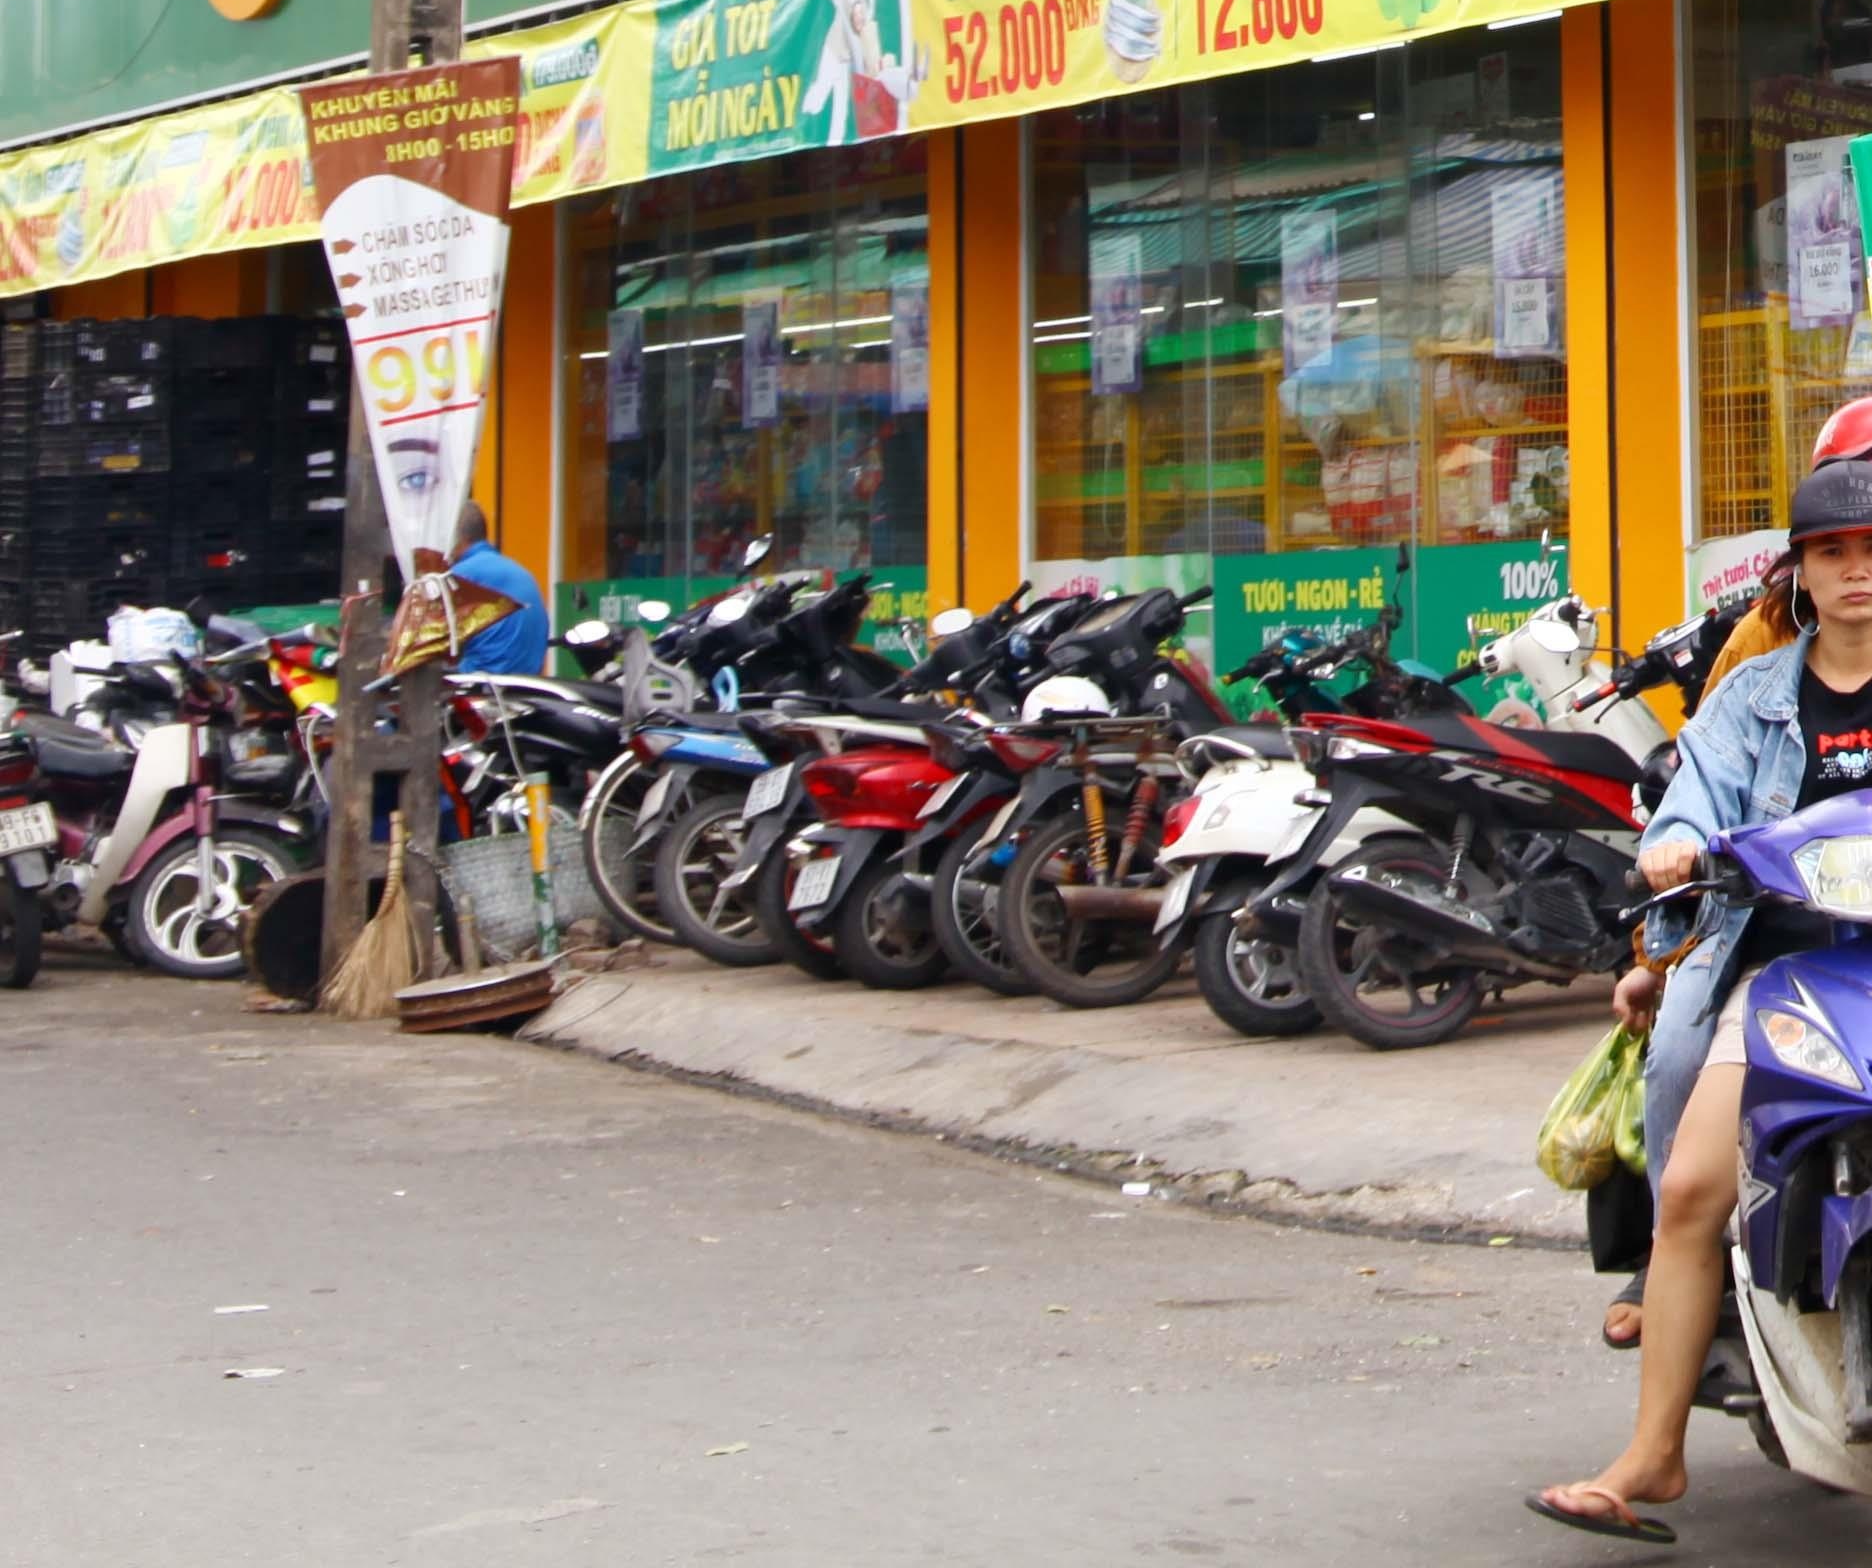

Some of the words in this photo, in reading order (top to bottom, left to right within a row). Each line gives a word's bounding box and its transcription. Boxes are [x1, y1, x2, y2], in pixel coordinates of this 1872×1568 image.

[311, 85, 411, 120] KHUYẾN
[415, 79, 459, 110] MÃI
[314, 113, 399, 145] KHUNG
[404, 100, 449, 135] GIỜ
[452, 95, 515, 123] VÀNG
[666, 66, 717, 152] MỖI
[716, 74, 798, 141] NGÀY
[413, 218, 448, 246] SÓC
[449, 216, 474, 239] DA
[366, 256, 417, 286] XÔNG
[1499, 560, 1559, 601] 100%
